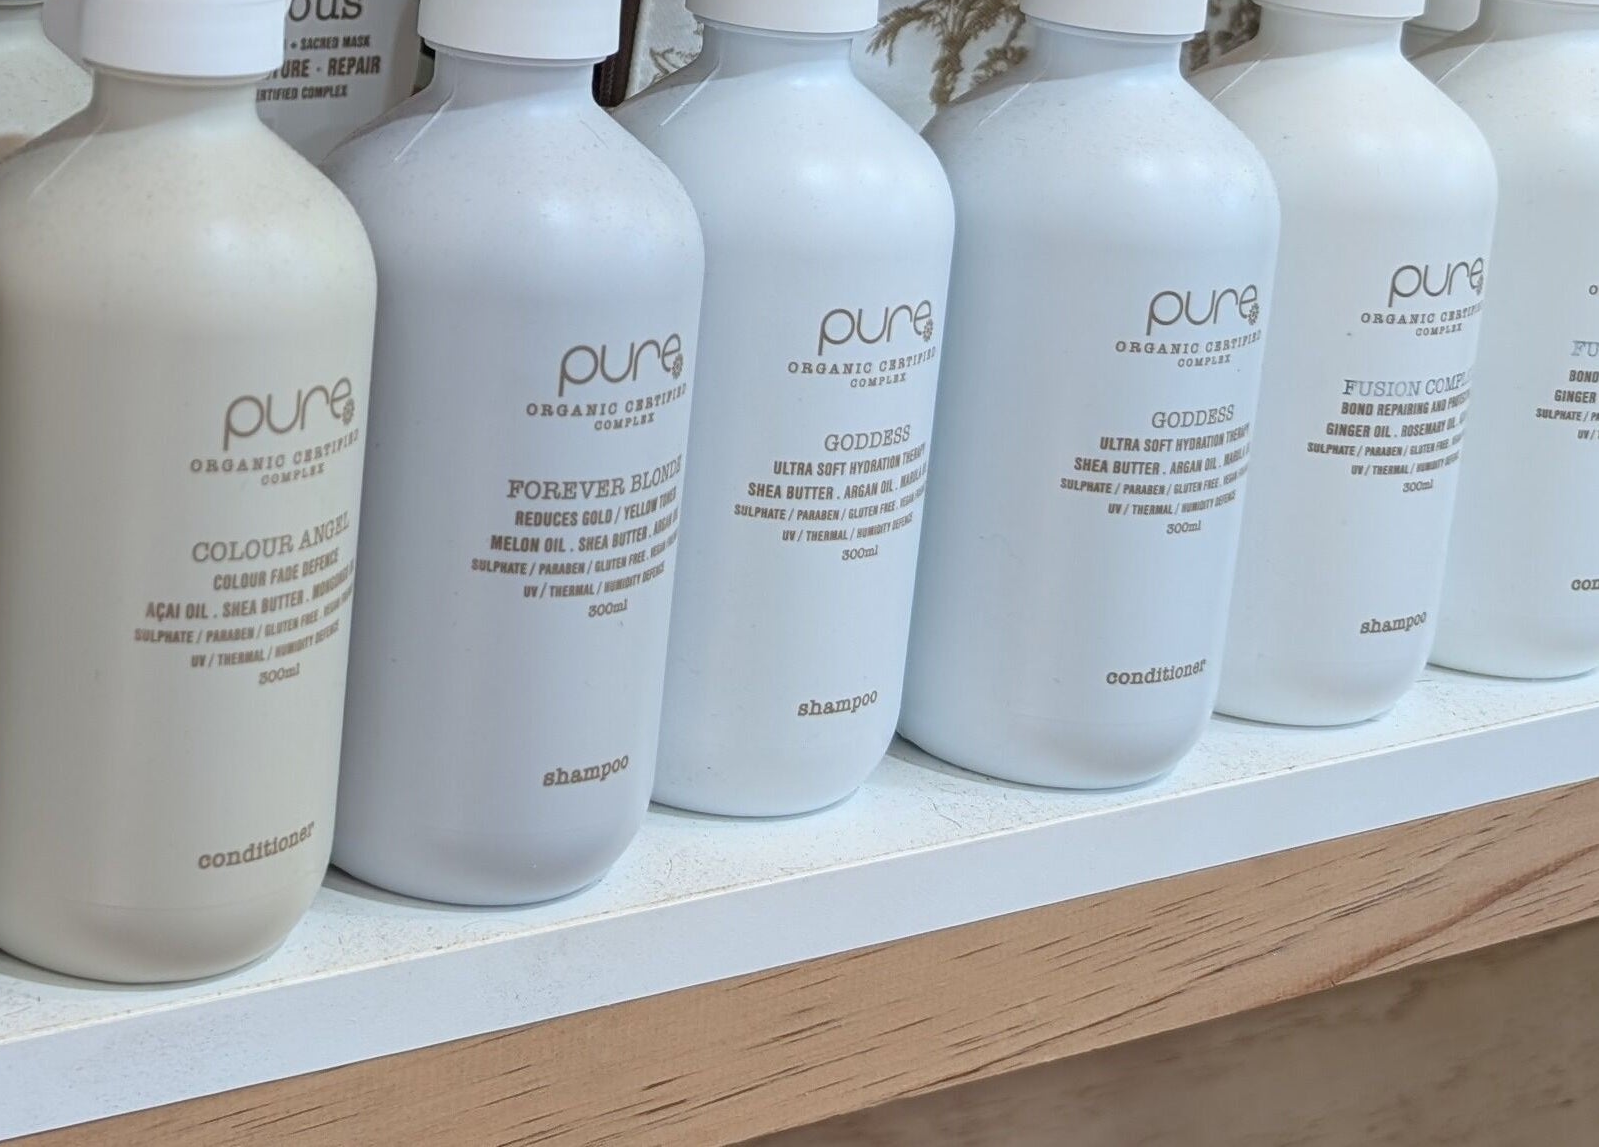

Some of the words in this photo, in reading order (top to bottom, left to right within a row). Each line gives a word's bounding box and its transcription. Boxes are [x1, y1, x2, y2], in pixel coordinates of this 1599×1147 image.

[300, 37, 338, 51] SACRED
[342, 35, 370, 48] MASK
[328, 55, 381, 76] REPAIR
[301, 84, 348, 99] COMPLEX
[1388, 257, 1484, 308] pure
[1146, 284, 1257, 336] pure
[1361, 313, 1435, 325] ORGANIC
[817, 300, 932, 356] pure
[1416, 323, 1463, 337] COMPLEX
[1115, 340, 1199, 355] ORGANIC
[1205, 329, 1261, 353] CERTIFIED
[558, 333, 681, 397] pure
[788, 361, 872, 374] ORGANIC
[879, 346, 936, 372] CERTIFIED
[1177, 354, 1231, 368] COMPLEX
[850, 372, 907, 388] COMPLEX
[1342, 379, 1421, 397] FUSION
[526, 402, 618, 417] ORGANIC
[625, 383, 687, 414] CERTIFIED
[1554, 389, 1597, 403] GINGER
[223, 377, 351, 452] pure
[1151, 404, 1235, 429] GODDESS
[1341, 402, 1373, 416] BOND
[1377, 402, 1429, 416] REPAIRING
[1431, 399, 1447, 413] AND
[1536, 407, 1582, 422] SULPHATE
[594, 413, 655, 431] COMPLEX
[1326, 422, 1370, 437] GINGER
[1374, 425, 1391, 438] OIL
[1401, 419, 1446, 437] ROSEMARY
[824, 424, 911, 452] GODDESS
[1100, 436, 1140, 452] ULTRA
[1143, 439, 1174, 453] SOFT
[1175, 432, 1224, 451] HYDRATION
[1577, 429, 1590, 439] UV
[190, 454, 285, 473] ORGANIC
[293, 428, 359, 464] CERTIFIED
[1306, 442, 1356, 456] SULPHATE
[1365, 446, 1403, 457] PARABEN
[1410, 442, 1435, 455] GLUTEN
[261, 462, 325, 485] COMPLEX
[773, 460, 813, 476] ULTRA
[816, 461, 847, 476] SOFT
[850, 454, 901, 475] HYDRATION
[1074, 456, 1108, 473] SHEA
[1113, 460, 1160, 476] BUTTER
[1169, 459, 1202, 475] ARGAN
[1205, 458, 1217, 471] OIL
[1351, 465, 1364, 475] UV
[1372, 464, 1409, 475] THERMAL
[507, 478, 625, 500] FOREVER
[629, 454, 683, 493] BLONDE
[1060, 478, 1112, 494] SULPHATE
[1123, 484, 1165, 496] PARABEN
[1173, 481, 1202, 495] GLUTEN
[1203, 477, 1219, 491] FREE
[748, 482, 782, 499] SHEA
[786, 485, 834, 501] BUTTER
[843, 483, 878, 500] ARGAN
[880, 479, 893, 495] OIL
[515, 510, 578, 527] REDUCES
[582, 508, 613, 526] GOLD
[624, 496, 658, 521] YELLOW
[734, 504, 786, 521] SULPHATE
[796, 509, 840, 521] PARABEN
[848, 505, 878, 519] GLUTEN
[880, 500, 896, 514] FREE
[1108, 503, 1121, 515] UV
[1132, 503, 1173, 516] THERMAL
[192, 534, 294, 562] COLOUR
[299, 510, 350, 550] ANGEL
[490, 534, 540, 553] MELON
[544, 537, 566, 553] OIL
[578, 535, 609, 552] SHEA
[612, 525, 648, 548] BUTTER
[782, 529, 795, 541] UV
[806, 529, 849, 542] THERMAL
[471, 558, 527, 575] SULPHATE
[538, 559, 585, 575] PARABEN
[594, 557, 627, 573] GLUTEN
[628, 550, 646, 567] FREE
[213, 572, 266, 591] COLOUR
[270, 563, 299, 584] FADE
[523, 584, 538, 598] UV
[549, 583, 595, 598] THERMAL
[146, 601, 180, 624] AÇAI
[185, 603, 208, 619] OIL
[222, 600, 257, 619] SHEA
[261, 589, 304, 614] BUTTER
[588, 598, 628, 618] 300ml
[134, 628, 194, 644] SULPHATE
[206, 625, 254, 643] PARABEN
[264, 619, 299, 637] GLUTEN
[1359, 611, 1427, 634] shampoo
[191, 654, 206, 668] UV
[1106, 658, 1206, 685] conditioner
[797, 690, 878, 717] shampoo
[543, 755, 629, 787] shampoo
[197, 821, 315, 870] conditioner
